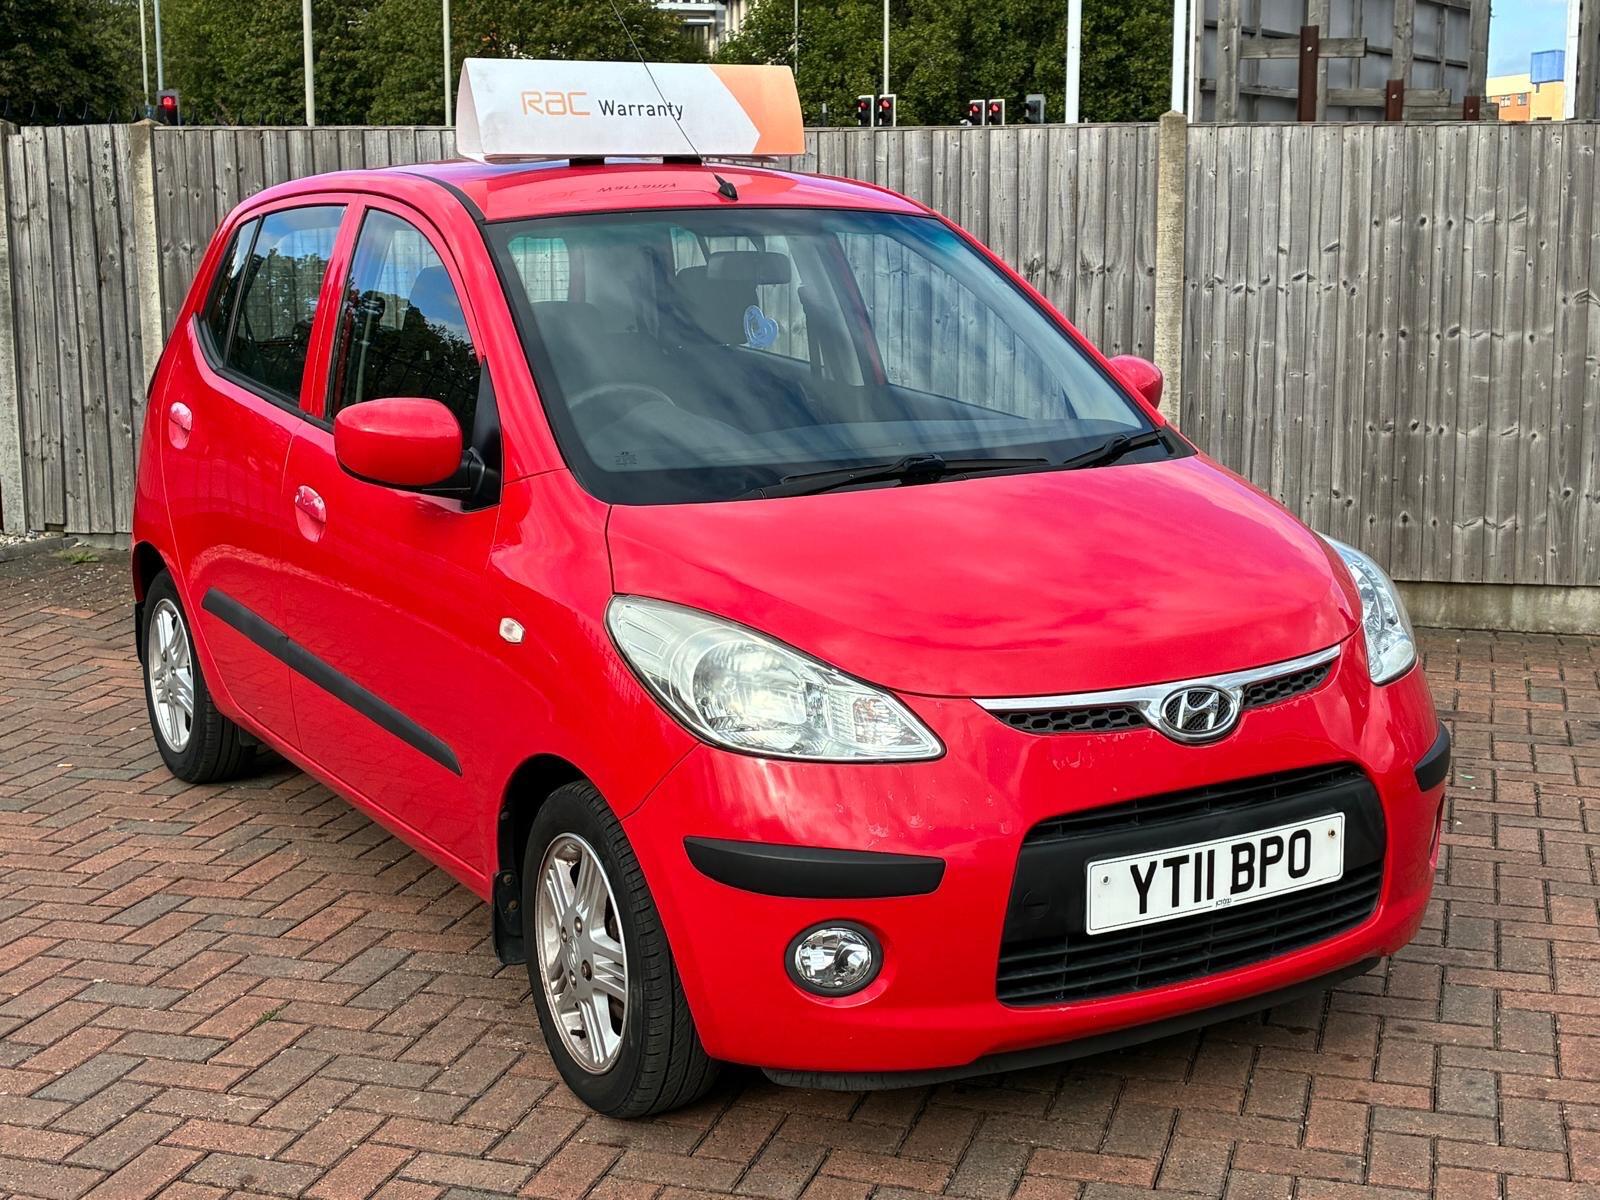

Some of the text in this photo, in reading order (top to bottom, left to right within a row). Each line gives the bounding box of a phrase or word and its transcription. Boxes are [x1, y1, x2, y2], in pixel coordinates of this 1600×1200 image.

[598, 99, 684, 121] Warranty
[1130, 828, 1312, 915] YT11 BPO
